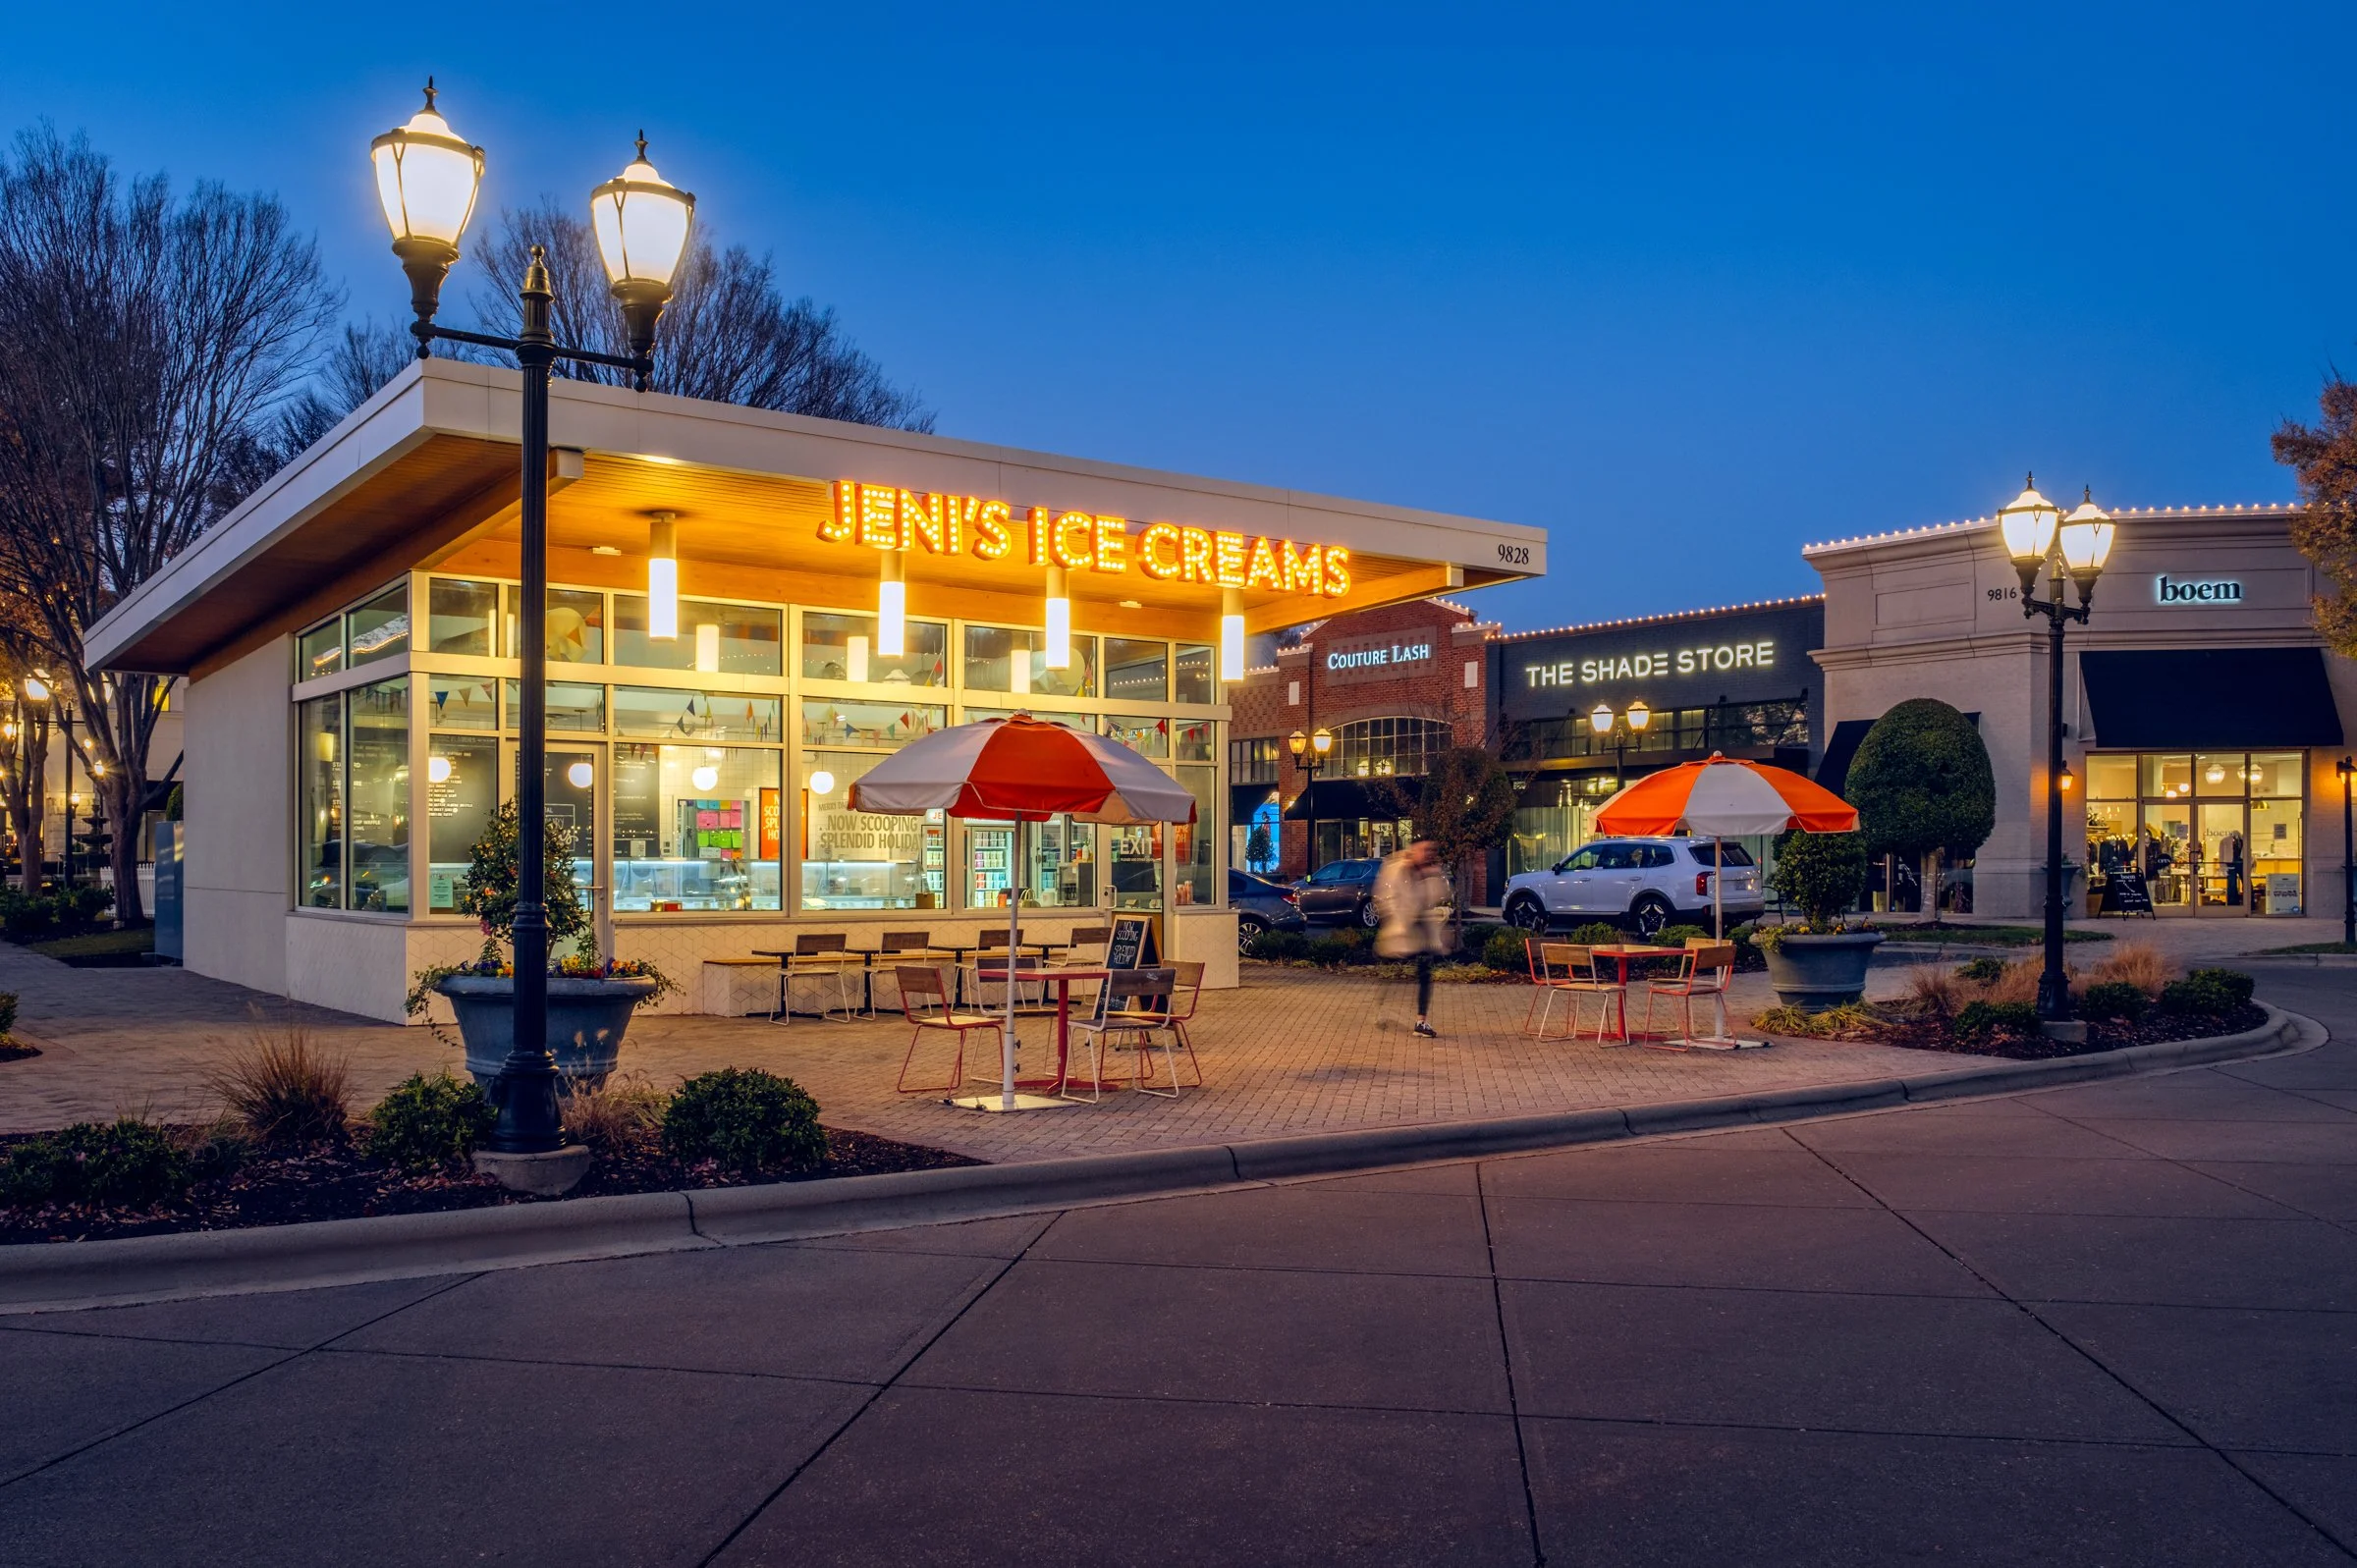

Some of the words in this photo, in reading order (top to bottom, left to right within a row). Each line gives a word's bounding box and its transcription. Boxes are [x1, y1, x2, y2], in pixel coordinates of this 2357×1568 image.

[816, 479, 1011, 561] JENI'S
[1027, 506, 1127, 573] ICE
[1135, 521, 1351, 599] CREAMS
[1498, 543, 1530, 566] 9828
[1987, 587, 2018, 602] 9816
[2159, 574, 2243, 602] boem
[1391, 643, 1431, 664] LASH
[1525, 663, 1574, 687] THE
[1580, 653, 1670, 683] SHADE
[1676, 641, 1775, 674] STORE
[827, 814, 858, 832] NOW
[860, 815, 919, 833] SCOOPING
[819, 832, 875, 849] SPLENDID
[1120, 837, 1155, 855] EXIT
